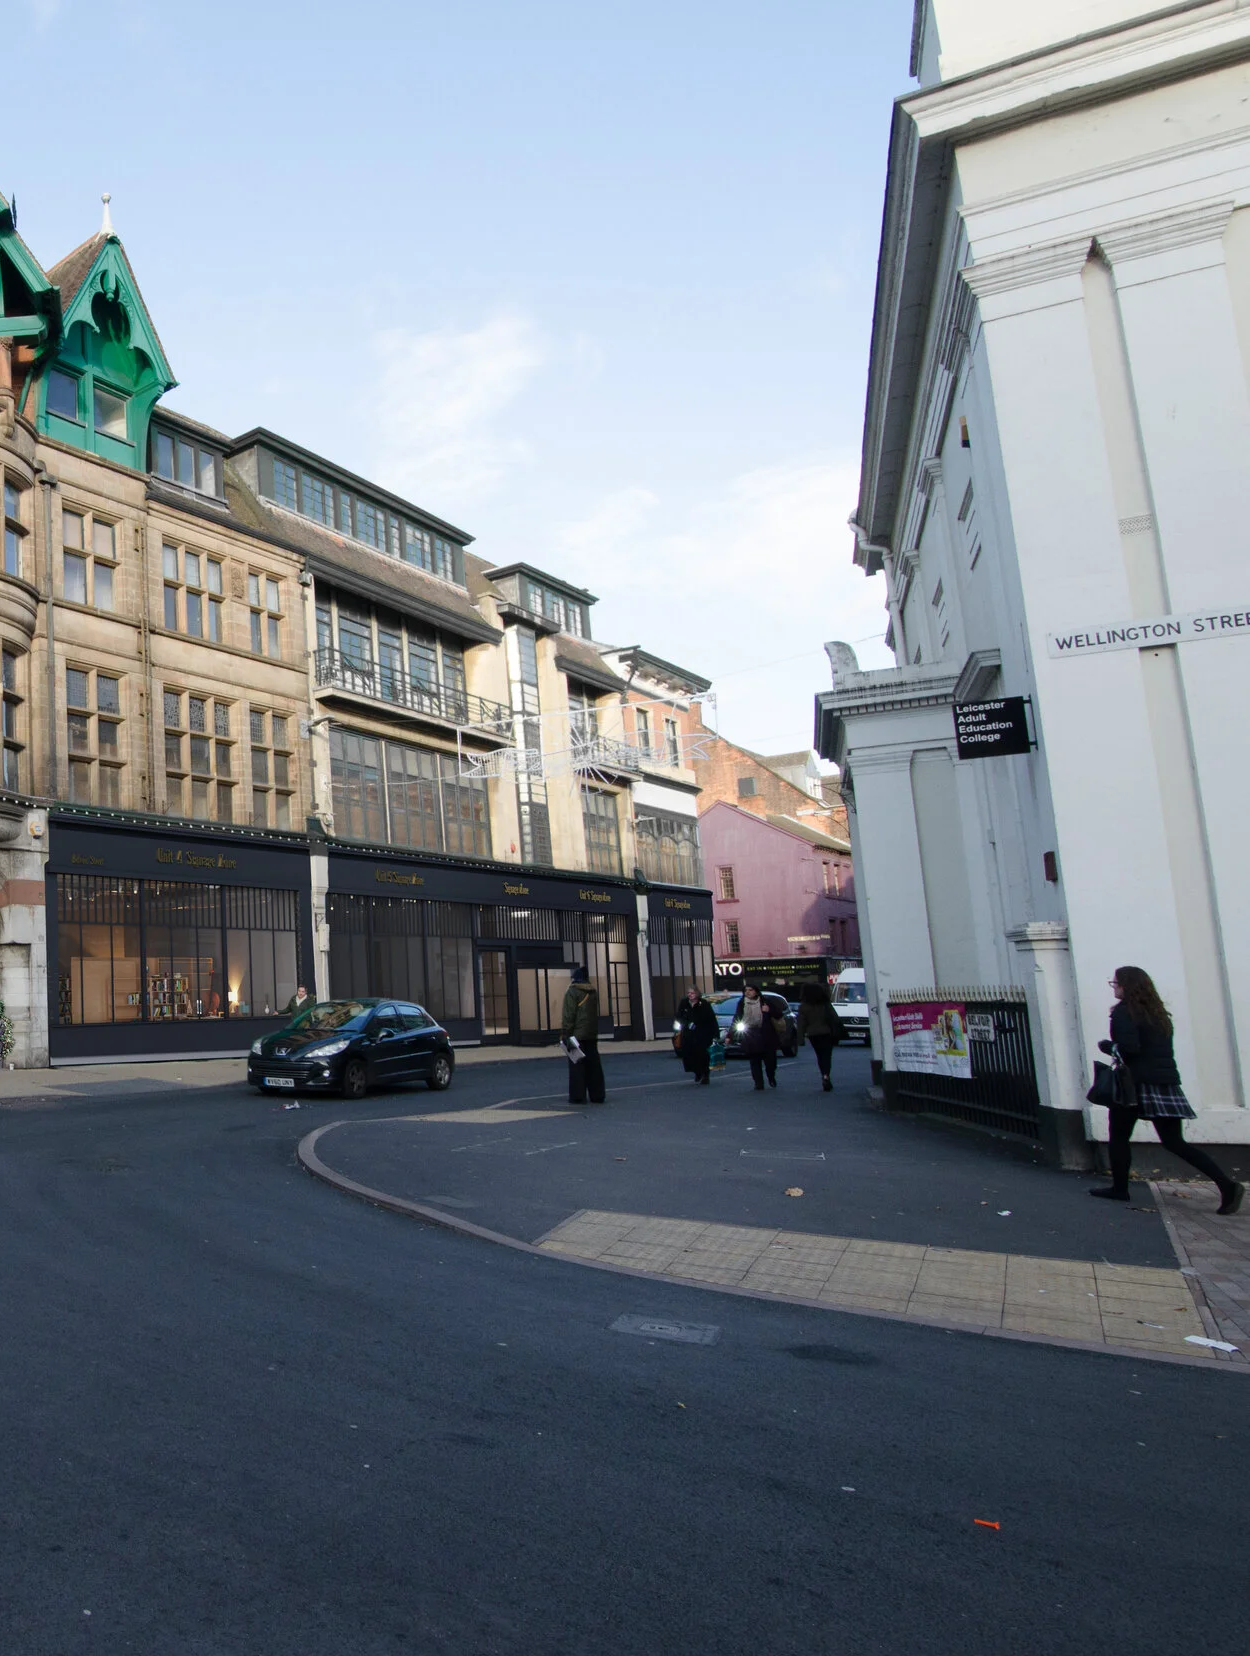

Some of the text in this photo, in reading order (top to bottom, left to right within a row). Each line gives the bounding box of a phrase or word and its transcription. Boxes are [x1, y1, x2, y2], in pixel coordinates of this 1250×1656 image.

[1055, 621, 1181, 650] WELLINGTON
[956, 702, 1005, 714] Leicester
[957, 713, 986, 724] Adult
[958, 721, 1013, 733] Education
[959, 733, 1000, 744] College
[157, 847, 172, 863] Unit
